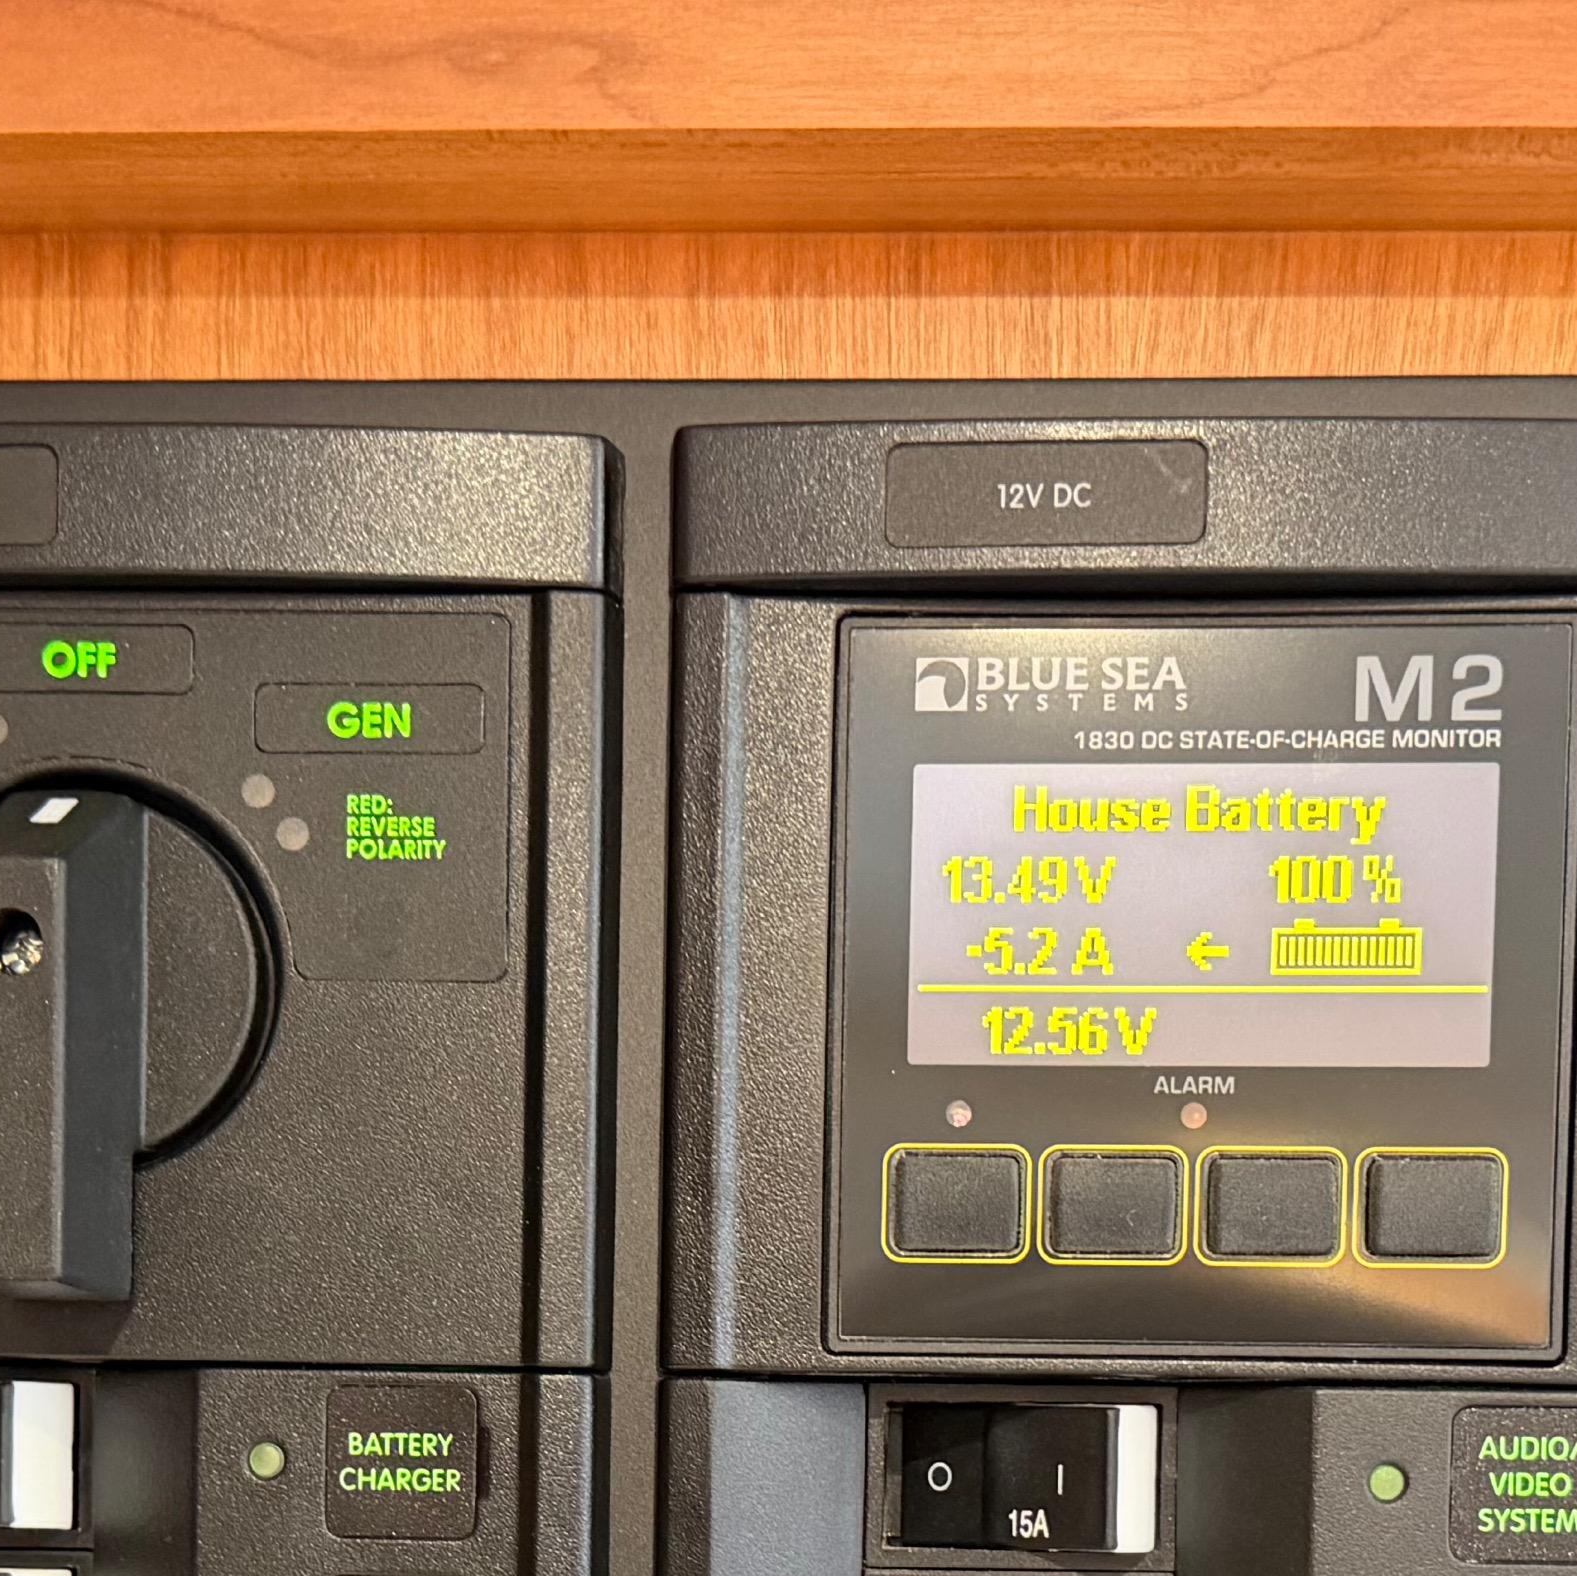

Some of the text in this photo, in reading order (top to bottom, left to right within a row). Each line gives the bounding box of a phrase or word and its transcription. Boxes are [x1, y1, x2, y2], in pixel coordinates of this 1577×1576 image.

[998, 483, 1091, 508] 12V DC
[42, 641, 116, 678] OFF
[978, 658, 1186, 690] BLUE SEA
[976, 693, 1187, 711] SYSTEMS
[327, 702, 411, 738] GEN
[1075, 729, 1501, 749] 1830 DC STATE-OF-CHARGE MONITOR
[347, 794, 392, 815] RED:
[1014, 783, 1388, 845] House Battery
[347, 816, 435, 838] REVERSE
[347, 838, 446, 859] POLARITY
[1268, 855, 1354, 904] 100
[1071, 927, 1114, 975] A
[1154, 1076, 1234, 1094] ALARM
[349, 1432, 453, 1456] BATTERY
[340, 1467, 460, 1494] CHARGER
[1489, 1472, 1573, 1497] VIDEO
[1009, 1509, 1049, 1538] 15A
